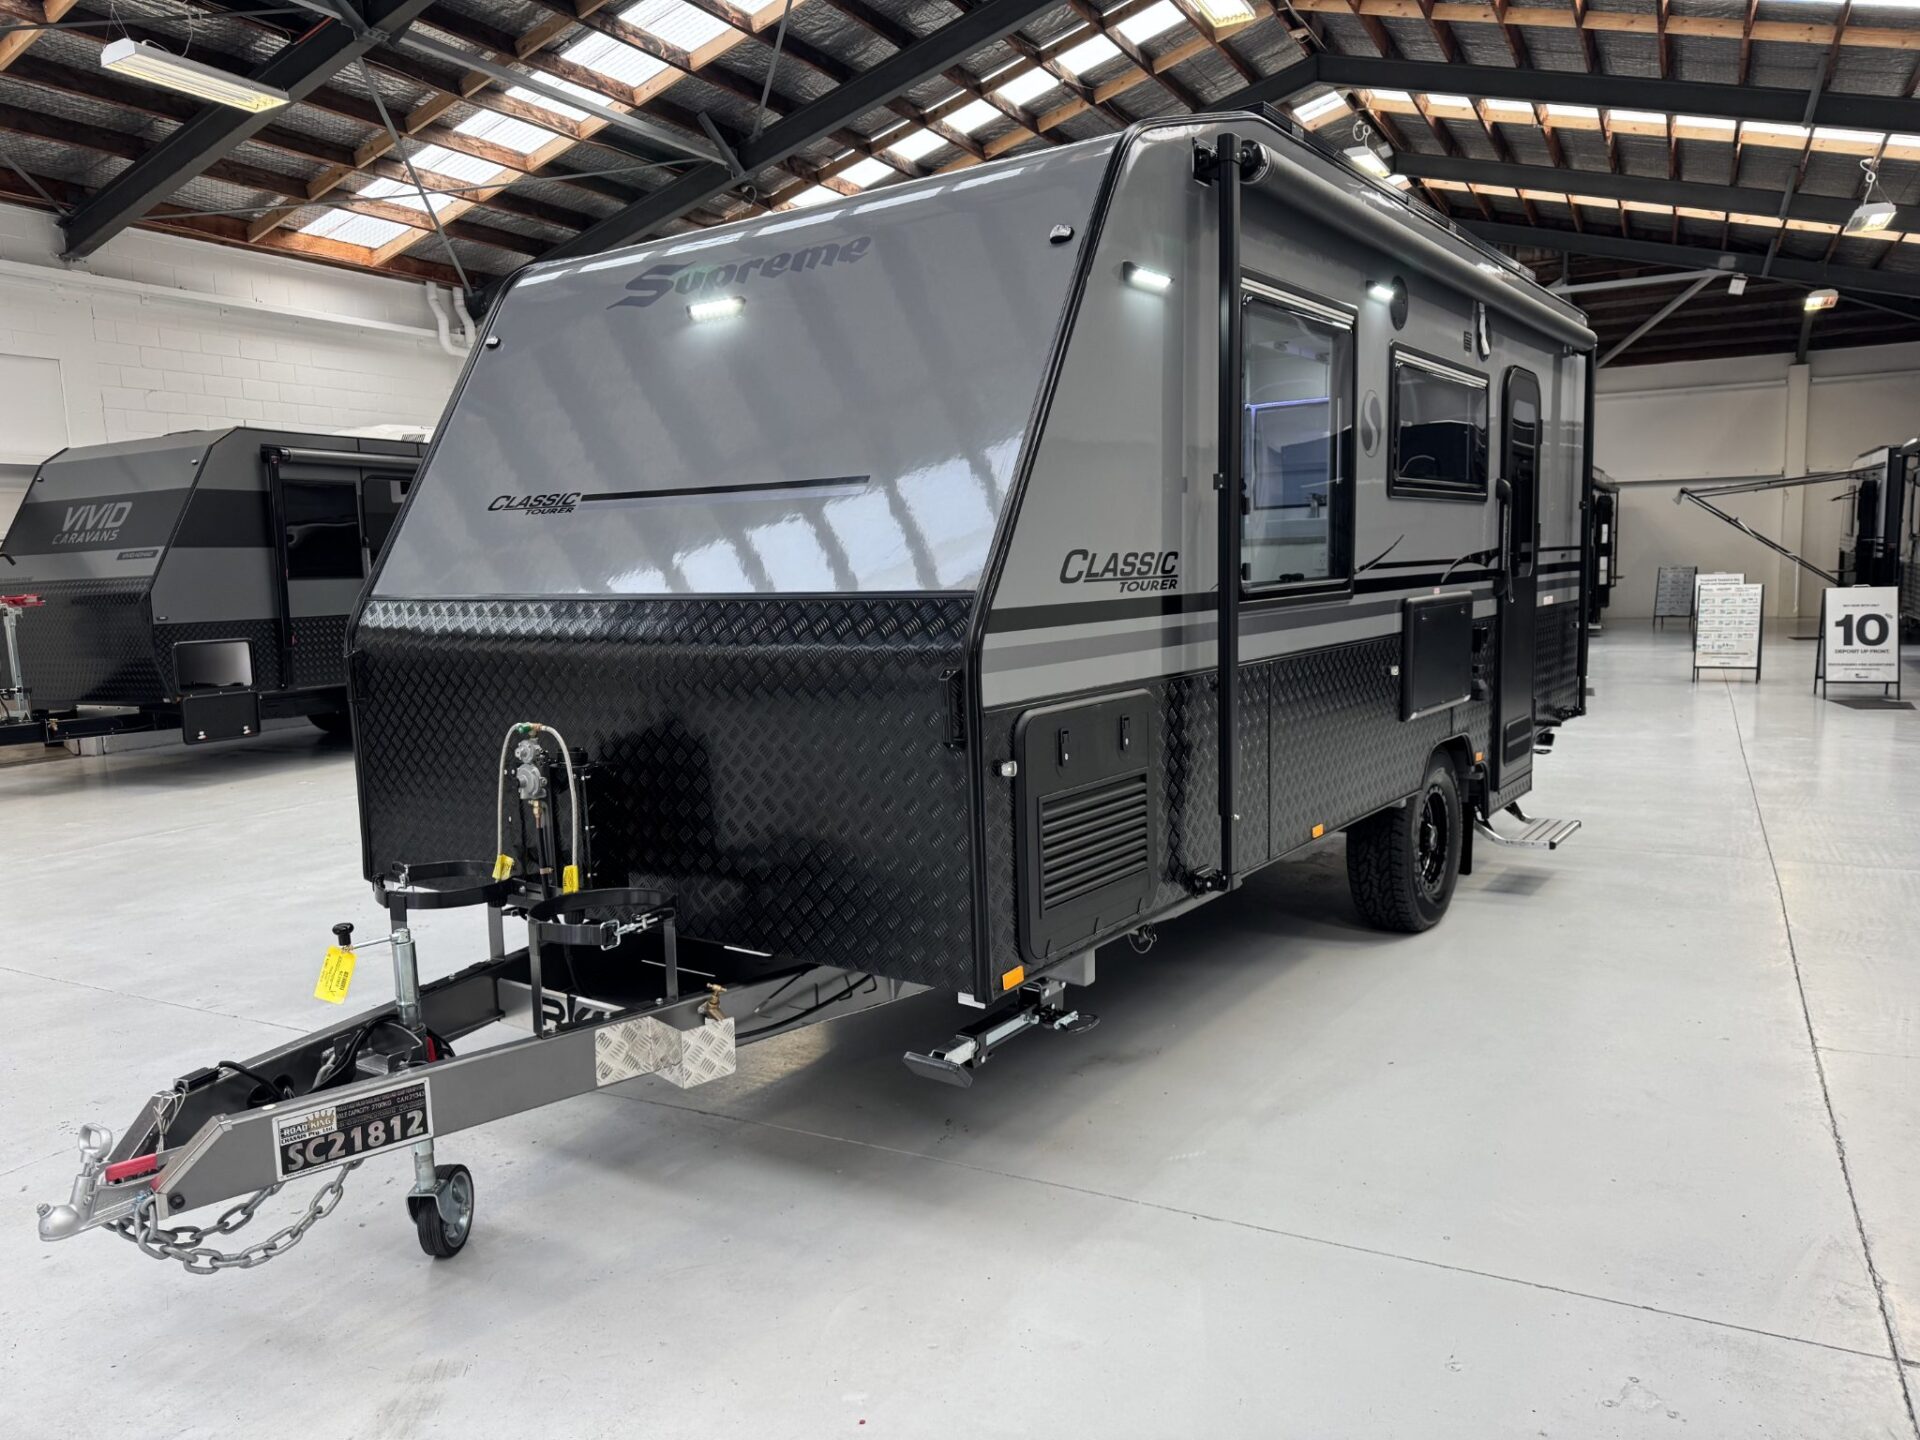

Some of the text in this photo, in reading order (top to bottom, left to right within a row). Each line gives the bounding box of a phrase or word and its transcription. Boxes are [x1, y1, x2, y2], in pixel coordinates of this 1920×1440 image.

[606, 236, 872, 310] Supreme
[488, 493, 581, 511] CLASSIC
[525, 507, 575, 515] TOURER
[52, 528, 120, 545] CARAVANS
[1060, 549, 1179, 584] CLASSIC
[1120, 579, 1178, 593] TOURER
[283, 1118, 331, 1136] ROAD KING
[288, 1109, 424, 1171] SC21812
